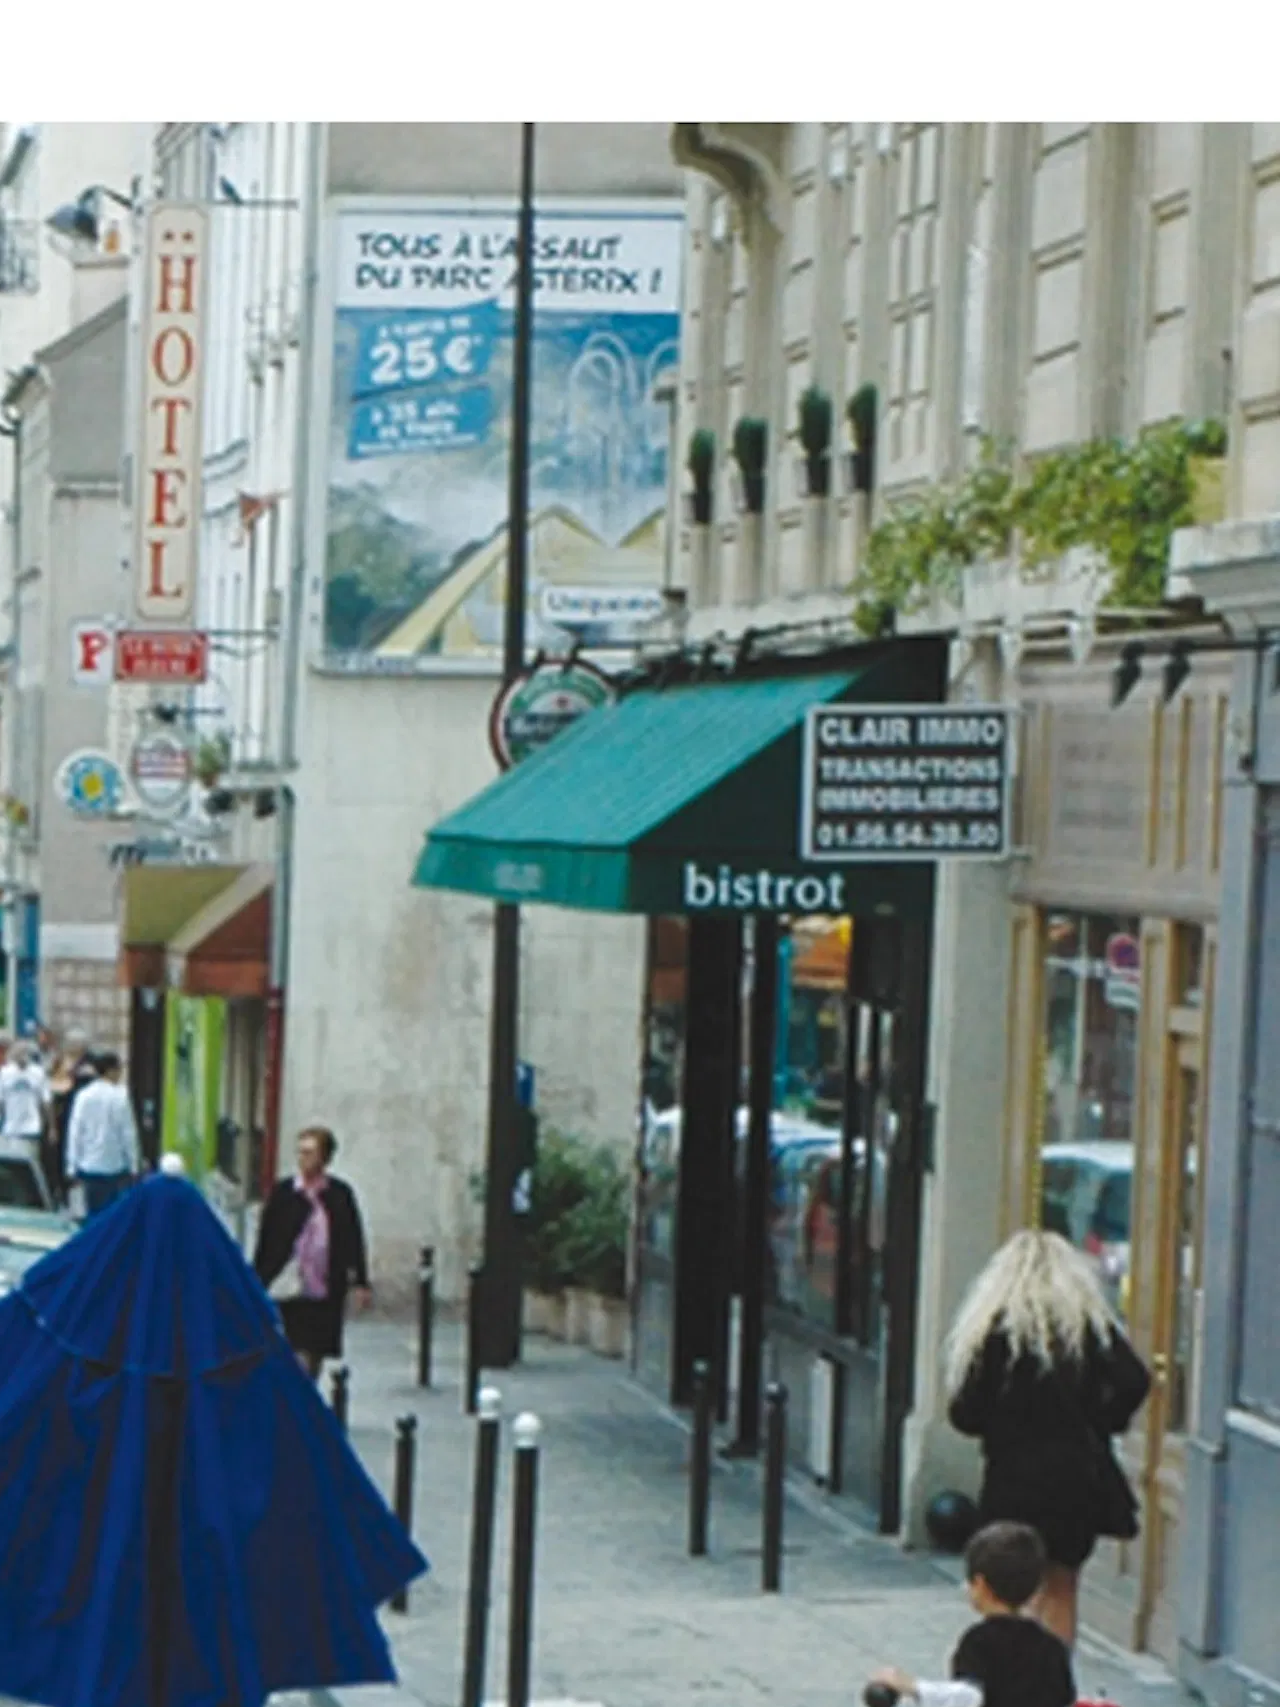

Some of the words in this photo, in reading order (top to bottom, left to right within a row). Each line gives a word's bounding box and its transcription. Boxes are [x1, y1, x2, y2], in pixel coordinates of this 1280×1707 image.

[357, 233, 442, 260] TOUS
[453, 229, 474, 259] À
[355, 263, 400, 290] DU
[412, 264, 493, 291] PARC
[147, 254, 194, 598] HOTEL
[819, 717, 911, 746] CLAIR
[917, 717, 1004, 746] IMMO
[819, 756, 1000, 782] TRANSACTIONS
[683, 862, 845, 910] bistrot
